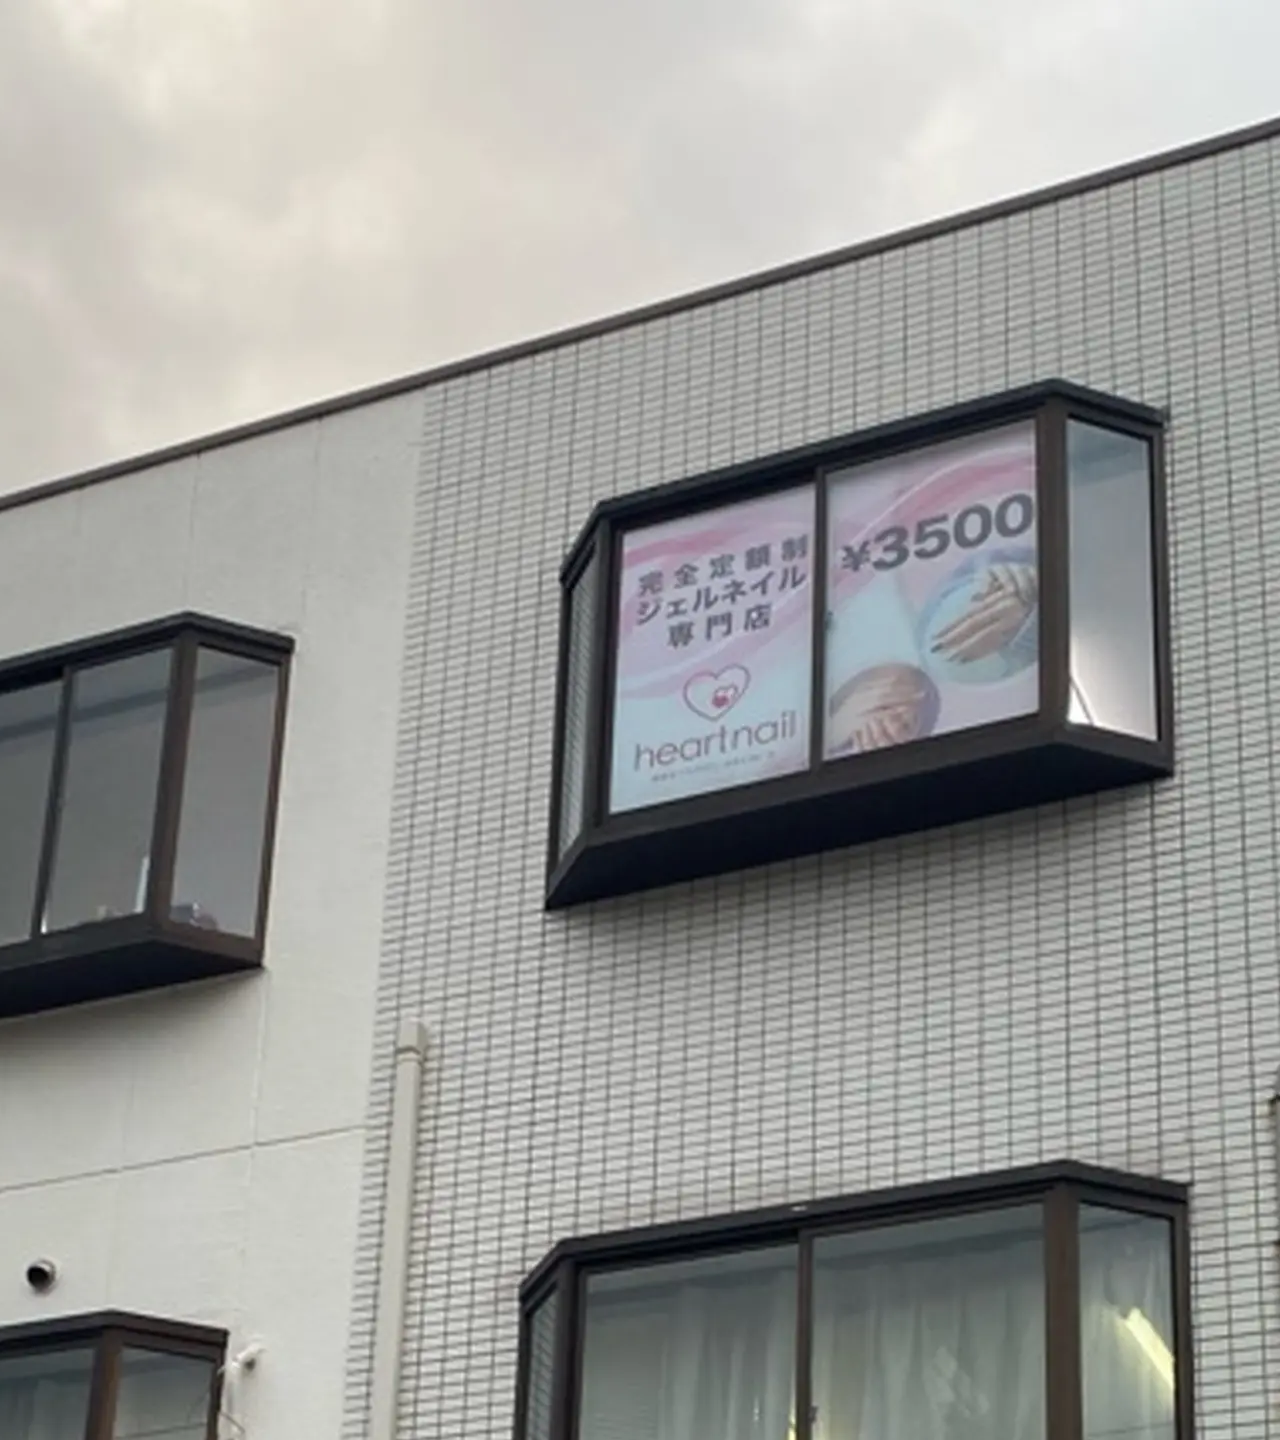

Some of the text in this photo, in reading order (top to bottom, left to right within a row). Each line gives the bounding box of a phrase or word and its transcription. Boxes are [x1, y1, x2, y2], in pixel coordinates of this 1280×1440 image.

[636, 565, 807, 626] ジェルネイル
[638, 534, 809, 598] 完全定額制
[667, 603, 772, 649] 専門店
